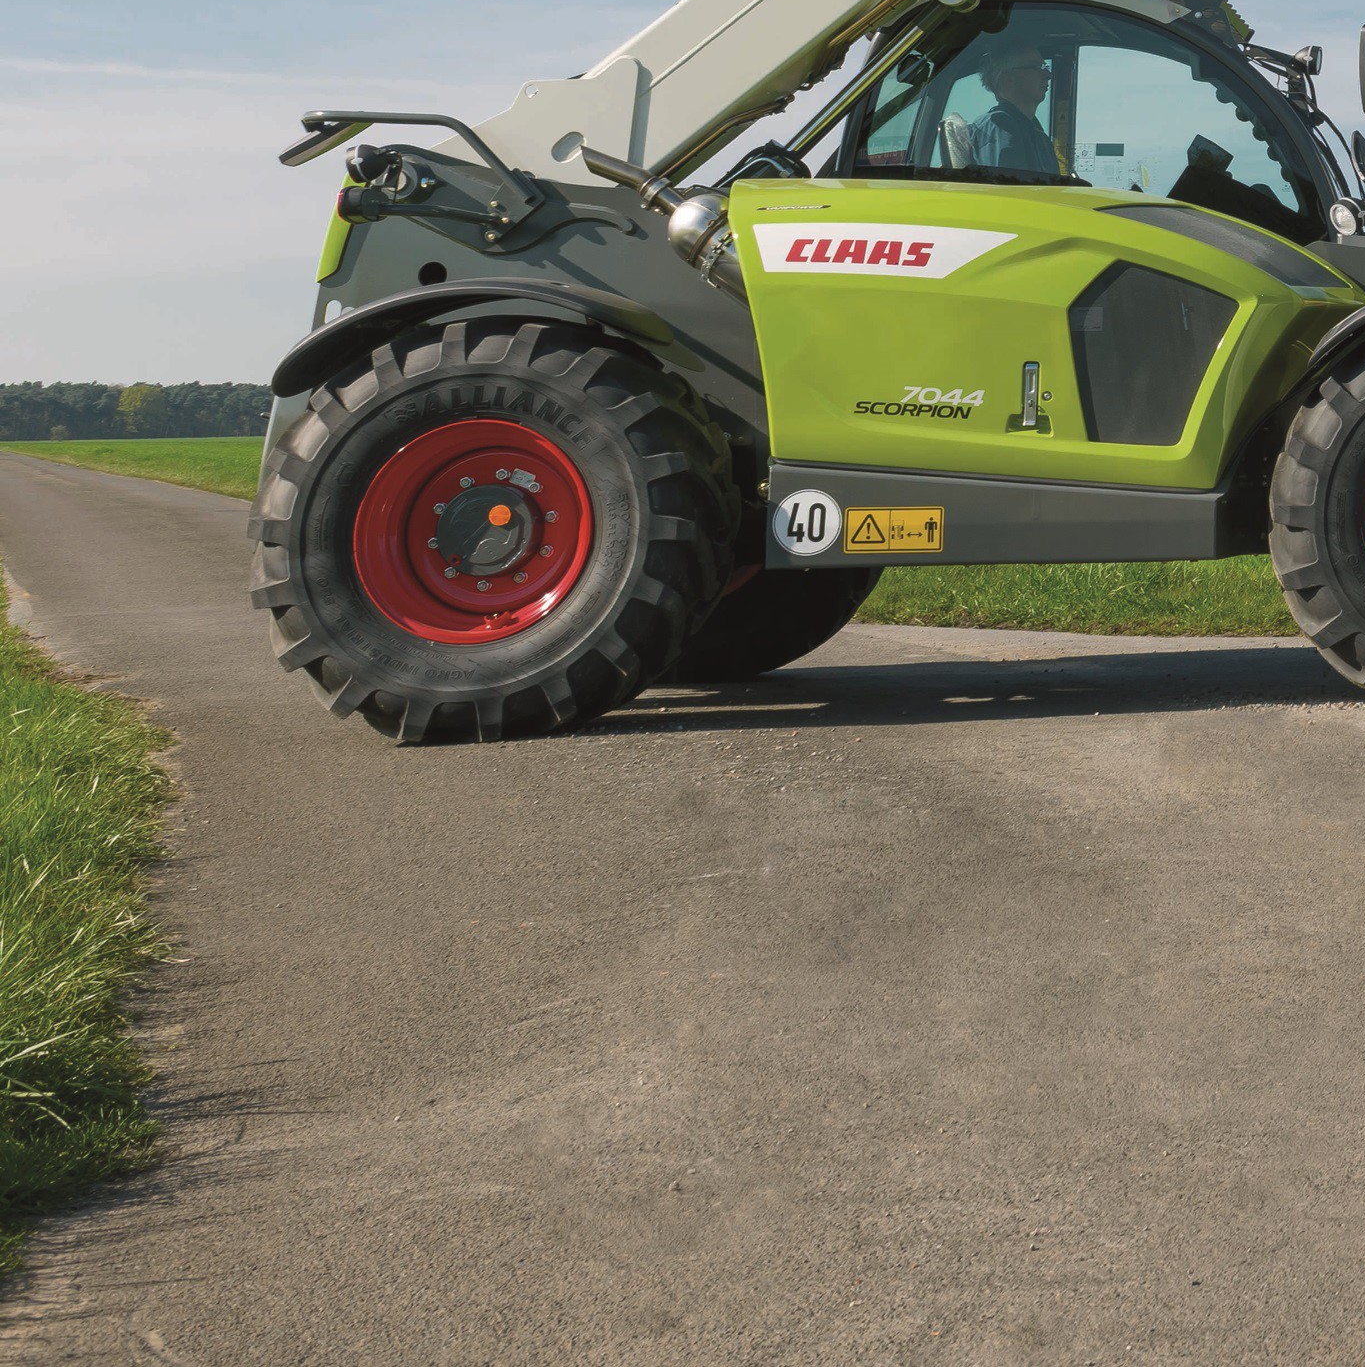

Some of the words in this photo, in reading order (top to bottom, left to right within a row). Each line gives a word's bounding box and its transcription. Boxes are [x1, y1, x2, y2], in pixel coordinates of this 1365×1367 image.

[785, 239, 935, 268] CLAAS
[853, 401, 972, 419] SCORPION
[900, 385, 985, 407] 7044
[414, 384, 599, 450] ALLIANCE
[786, 502, 827, 543] 40
